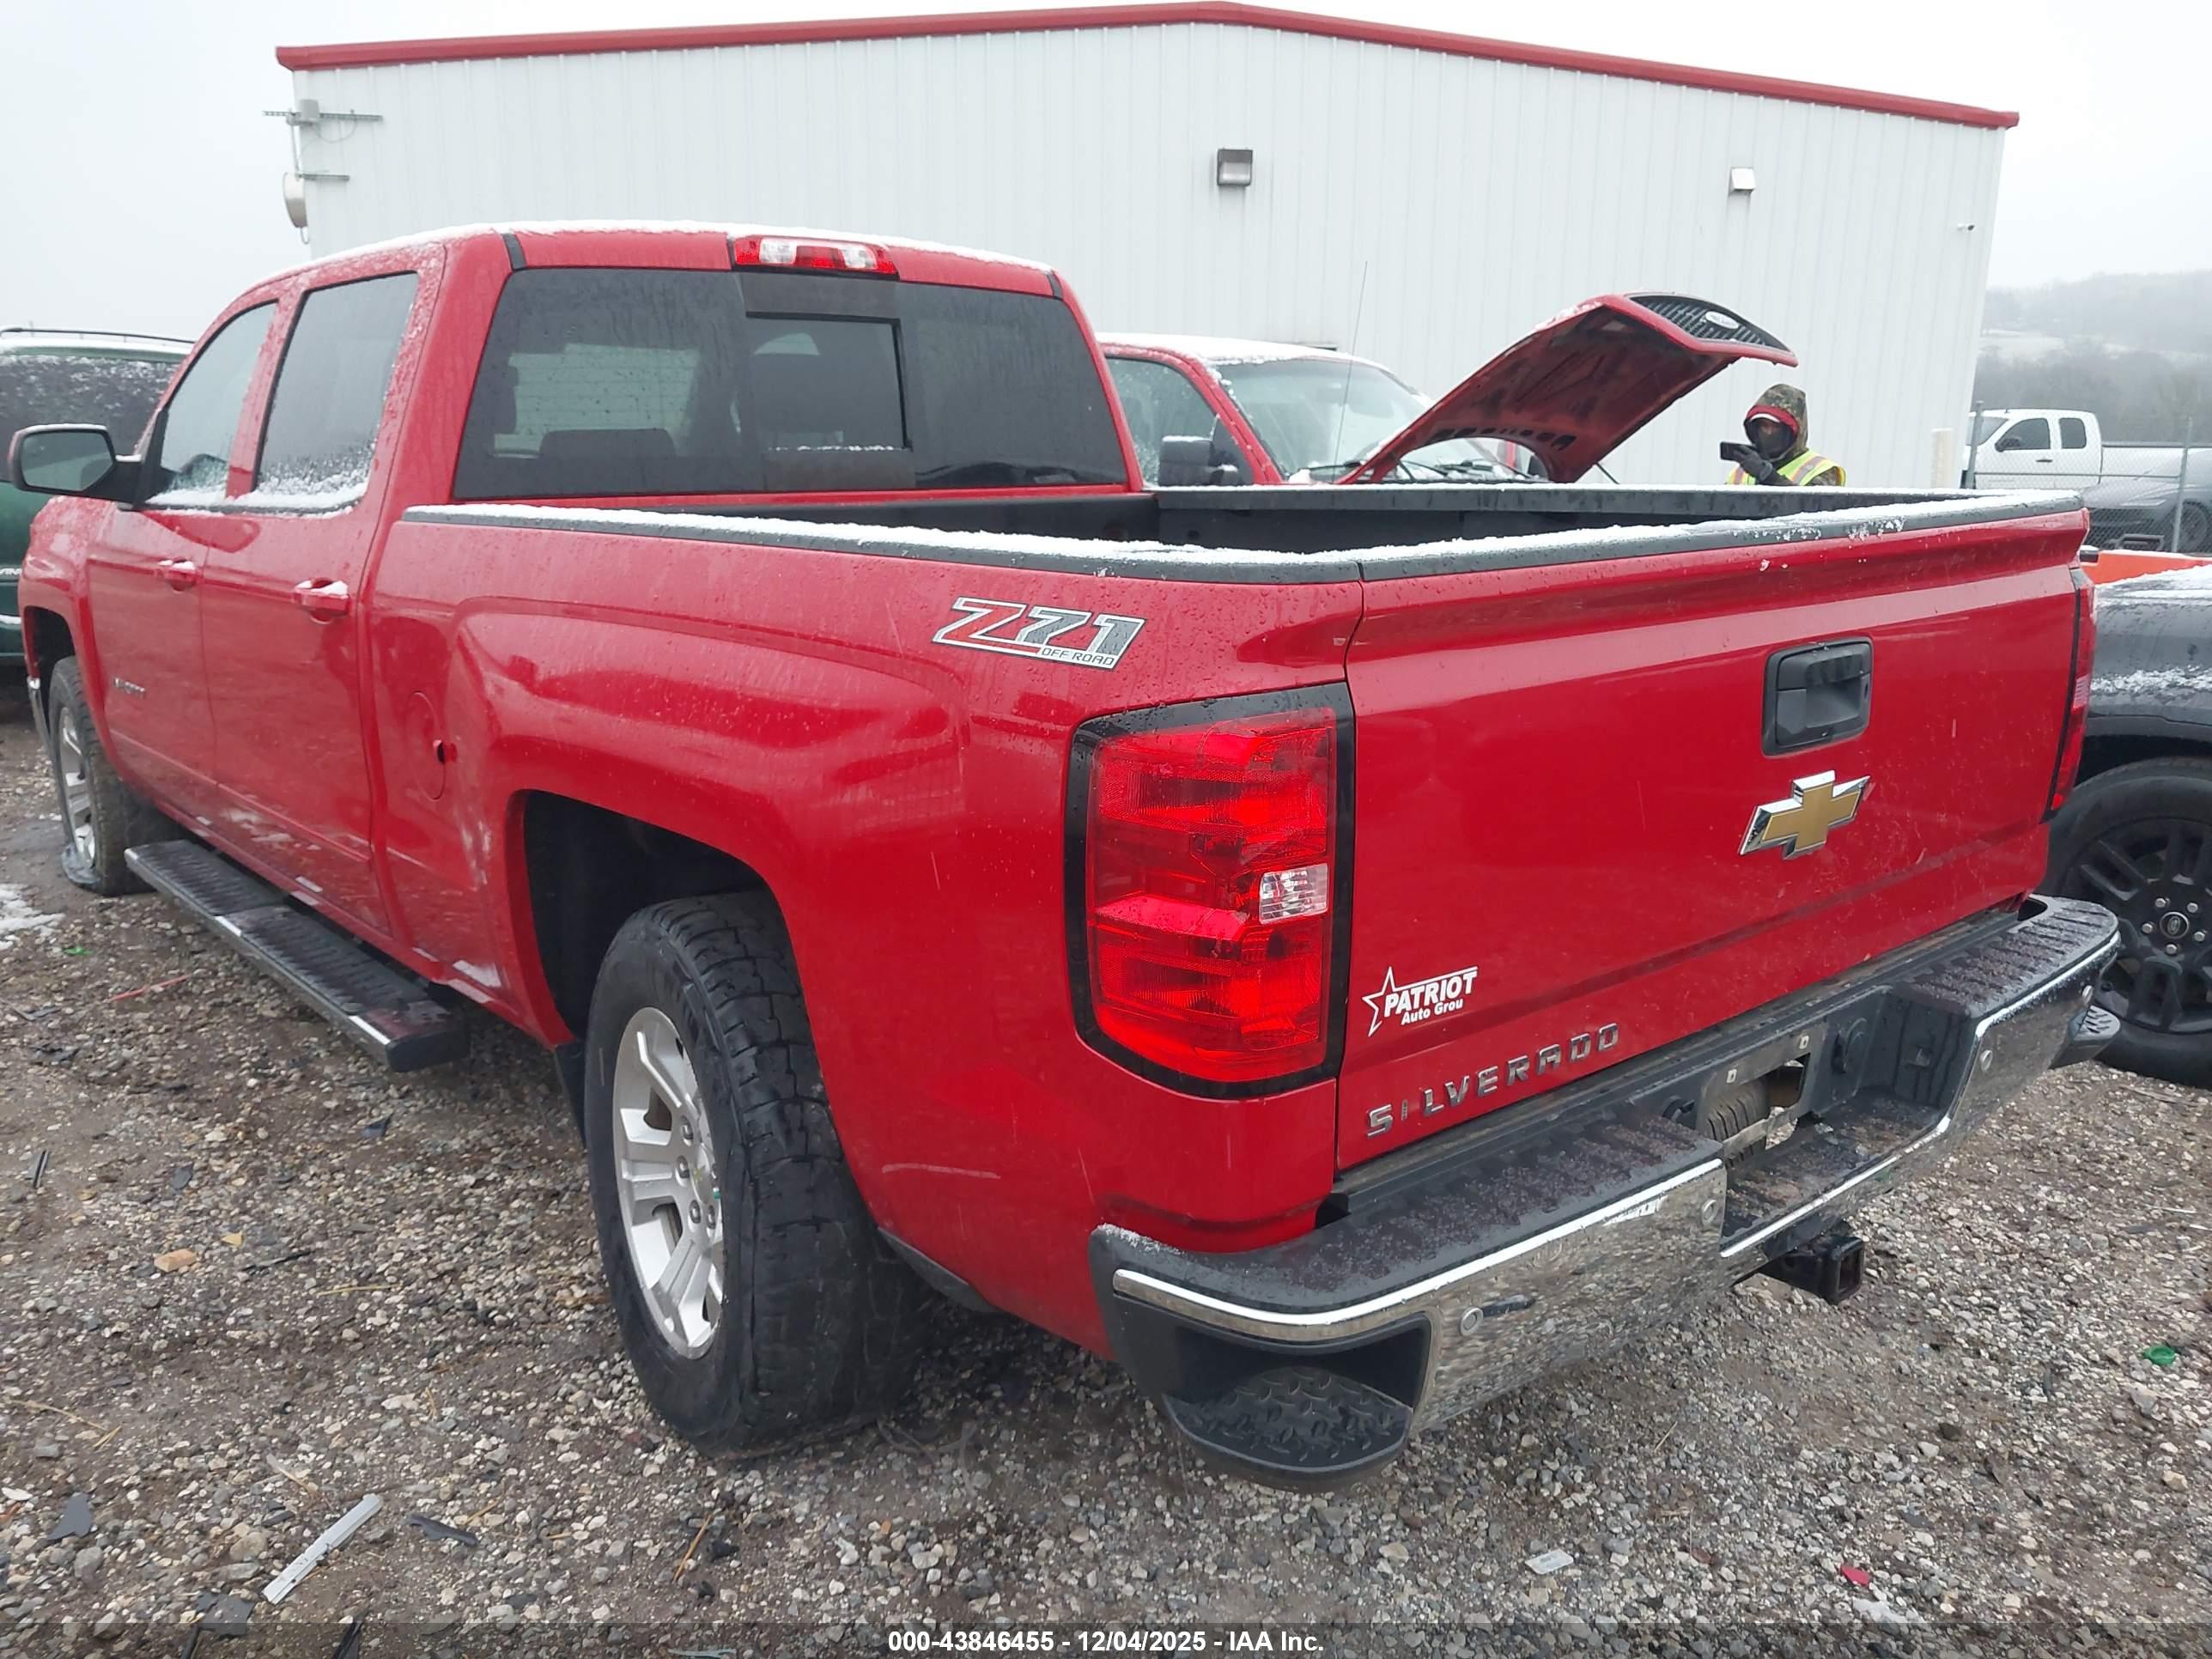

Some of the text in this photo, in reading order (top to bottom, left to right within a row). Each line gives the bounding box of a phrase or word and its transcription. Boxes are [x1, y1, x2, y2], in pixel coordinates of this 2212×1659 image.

[932, 596, 1147, 659] Z71
[1041, 647, 1115, 666] OFF ROAD
[1383, 970, 1478, 1018] PATRIOT
[1401, 998, 1464, 1025] Auto Grou
[1366, 1022, 1620, 1138] SILVERADO
